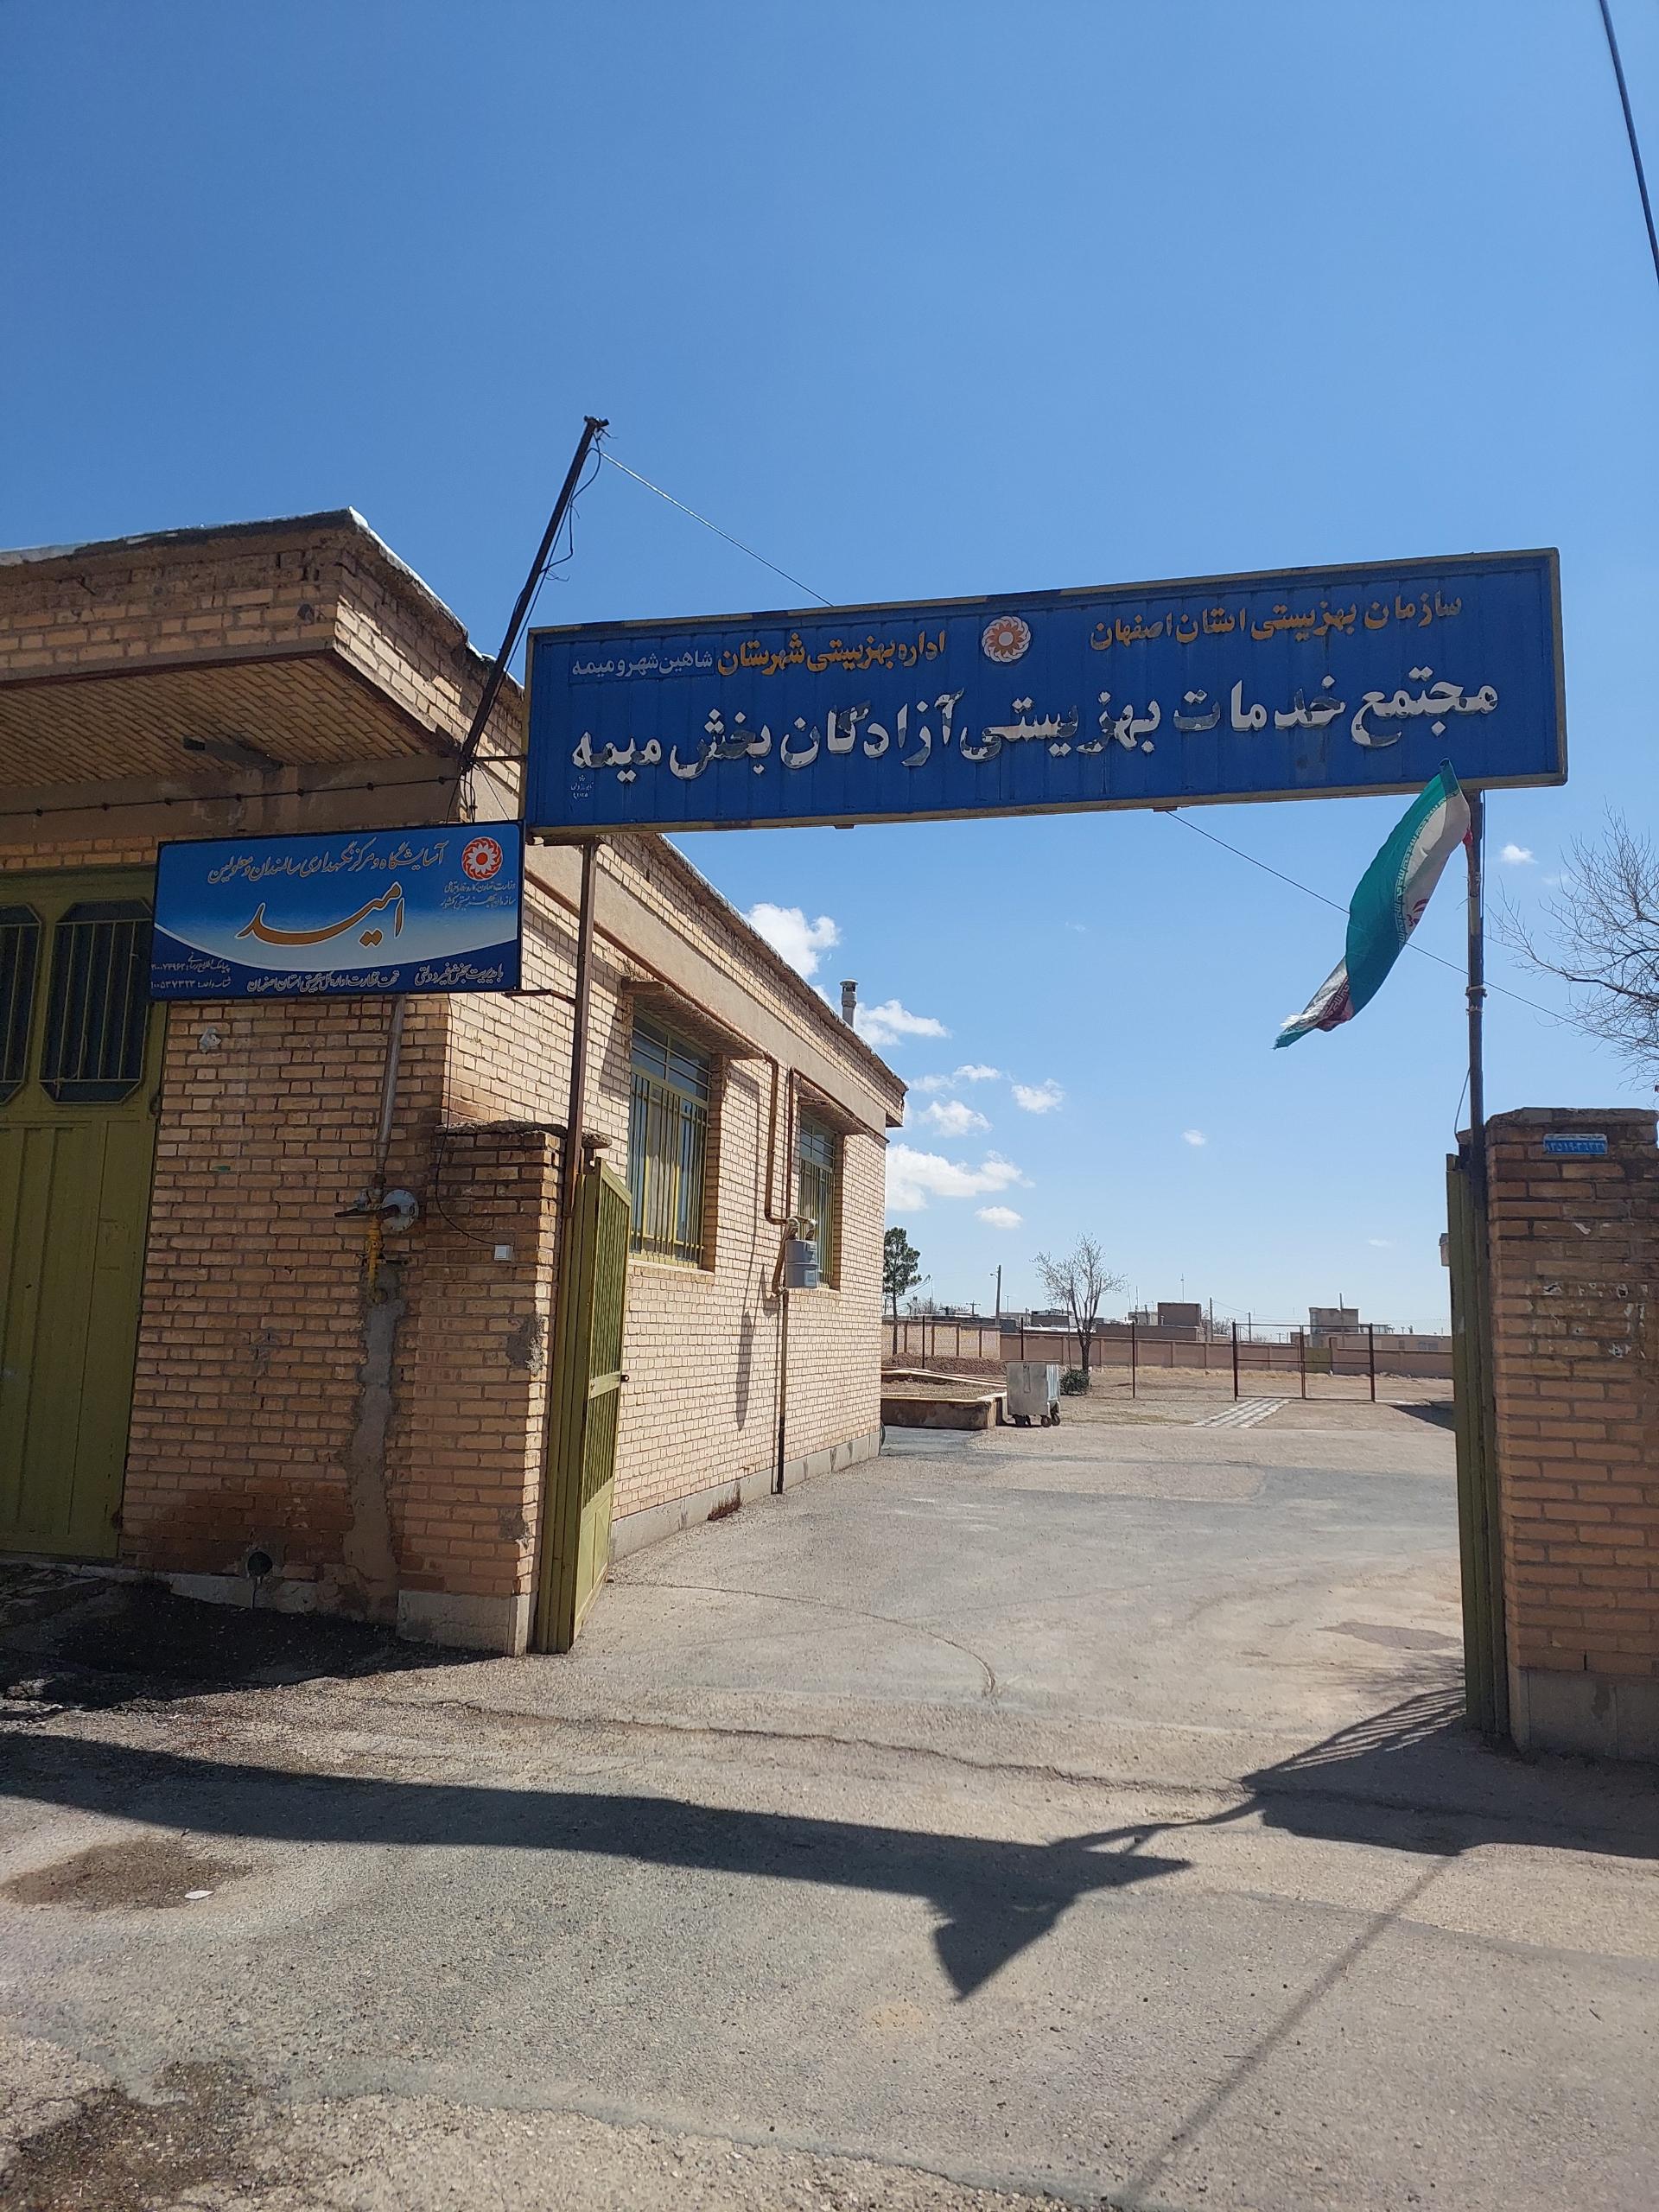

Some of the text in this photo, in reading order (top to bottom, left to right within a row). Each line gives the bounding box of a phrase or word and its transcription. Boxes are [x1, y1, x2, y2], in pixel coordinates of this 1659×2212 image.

[1090, 590, 1462, 651] سازمان بهزیستی استان اصفهان
[626, 652, 658, 674] شهر
[659, 650, 714, 676] شاهین
[716, 632, 804, 676] شهرستان
[807, 636, 895, 672] بهزیستی
[895, 630, 945, 667] اداره
[571, 654, 614, 677] میمه
[571, 666, 1498, 784] مجتمع خدمات بهزیستی آزادگان بخش میمه
[207, 855, 253, 884] معلولین
[248, 855, 302, 881] سالمندان
[300, 840, 358, 877] نگهداری
[347, 836, 377, 872] مرکز
[379, 839, 448, 870] آسایشگاه
[234, 881, 404, 949] امید
[448, 963, 472, 985] بخش
[466, 967, 498, 984] مدیریت
[497, 963, 504, 982] با
